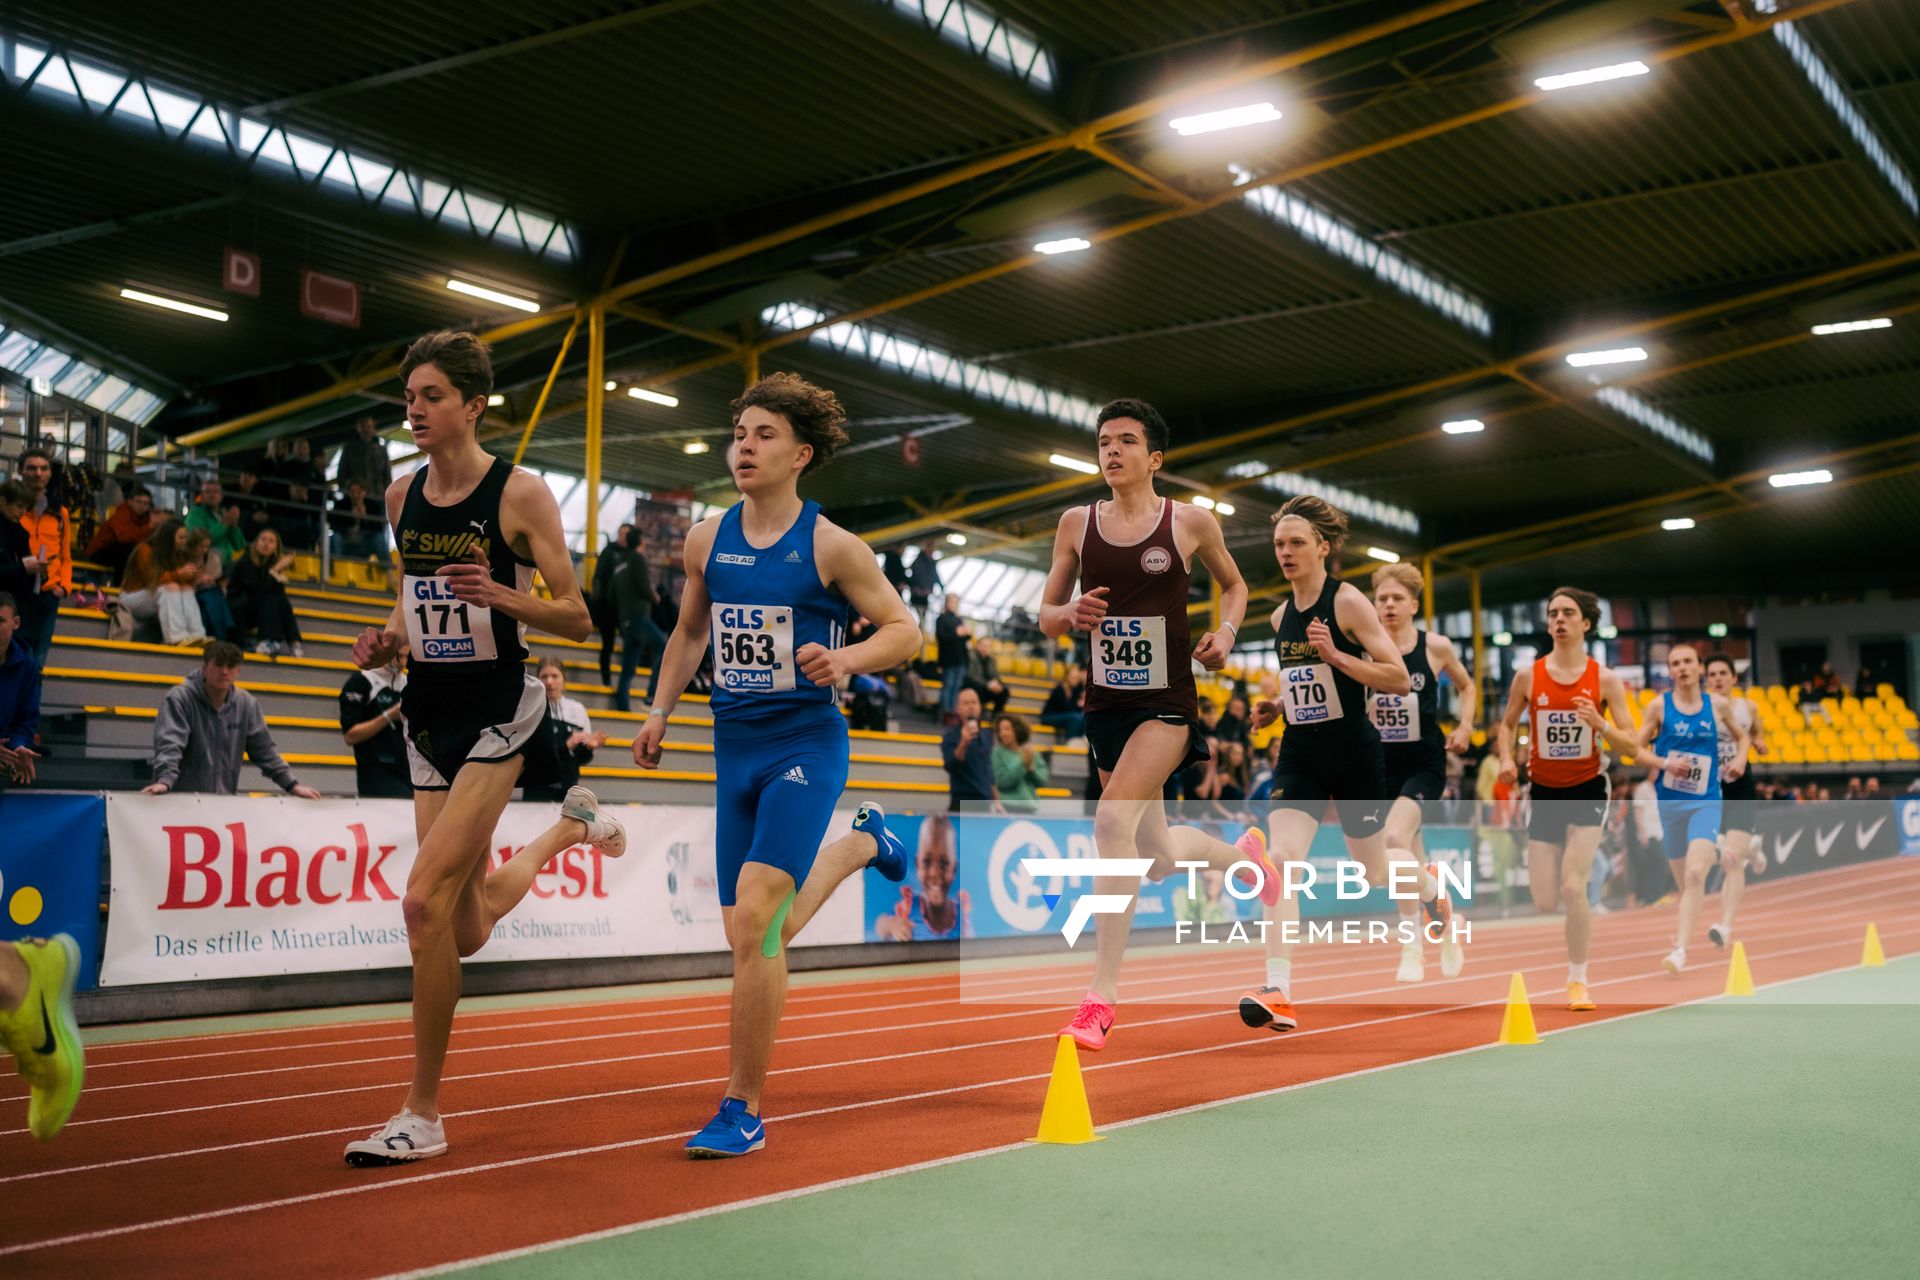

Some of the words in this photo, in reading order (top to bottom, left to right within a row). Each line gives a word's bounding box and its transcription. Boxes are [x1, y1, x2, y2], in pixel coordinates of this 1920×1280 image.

[230, 253, 255, 287] D
[741, 557, 754, 565] AG
[415, 603, 471, 634] 171
[442, 642, 472, 651] PLAN
[720, 632, 775, 666] 563
[1100, 640, 1153, 666] 348
[741, 673, 770, 682] PLAN
[1121, 672, 1148, 680] PLAN
[1288, 668, 1315, 683] GLS
[1289, 683, 1327, 706] 170
[1377, 696, 1402, 707] GLS
[1376, 709, 1409, 727] 555
[1548, 713, 1577, 724] GLS
[1546, 726, 1583, 743] 657
[157, 822, 400, 910] Black
[155, 934, 198, 957] Das
[206, 930, 263, 954] stille
[271, 924, 409, 951] Mineralwass
